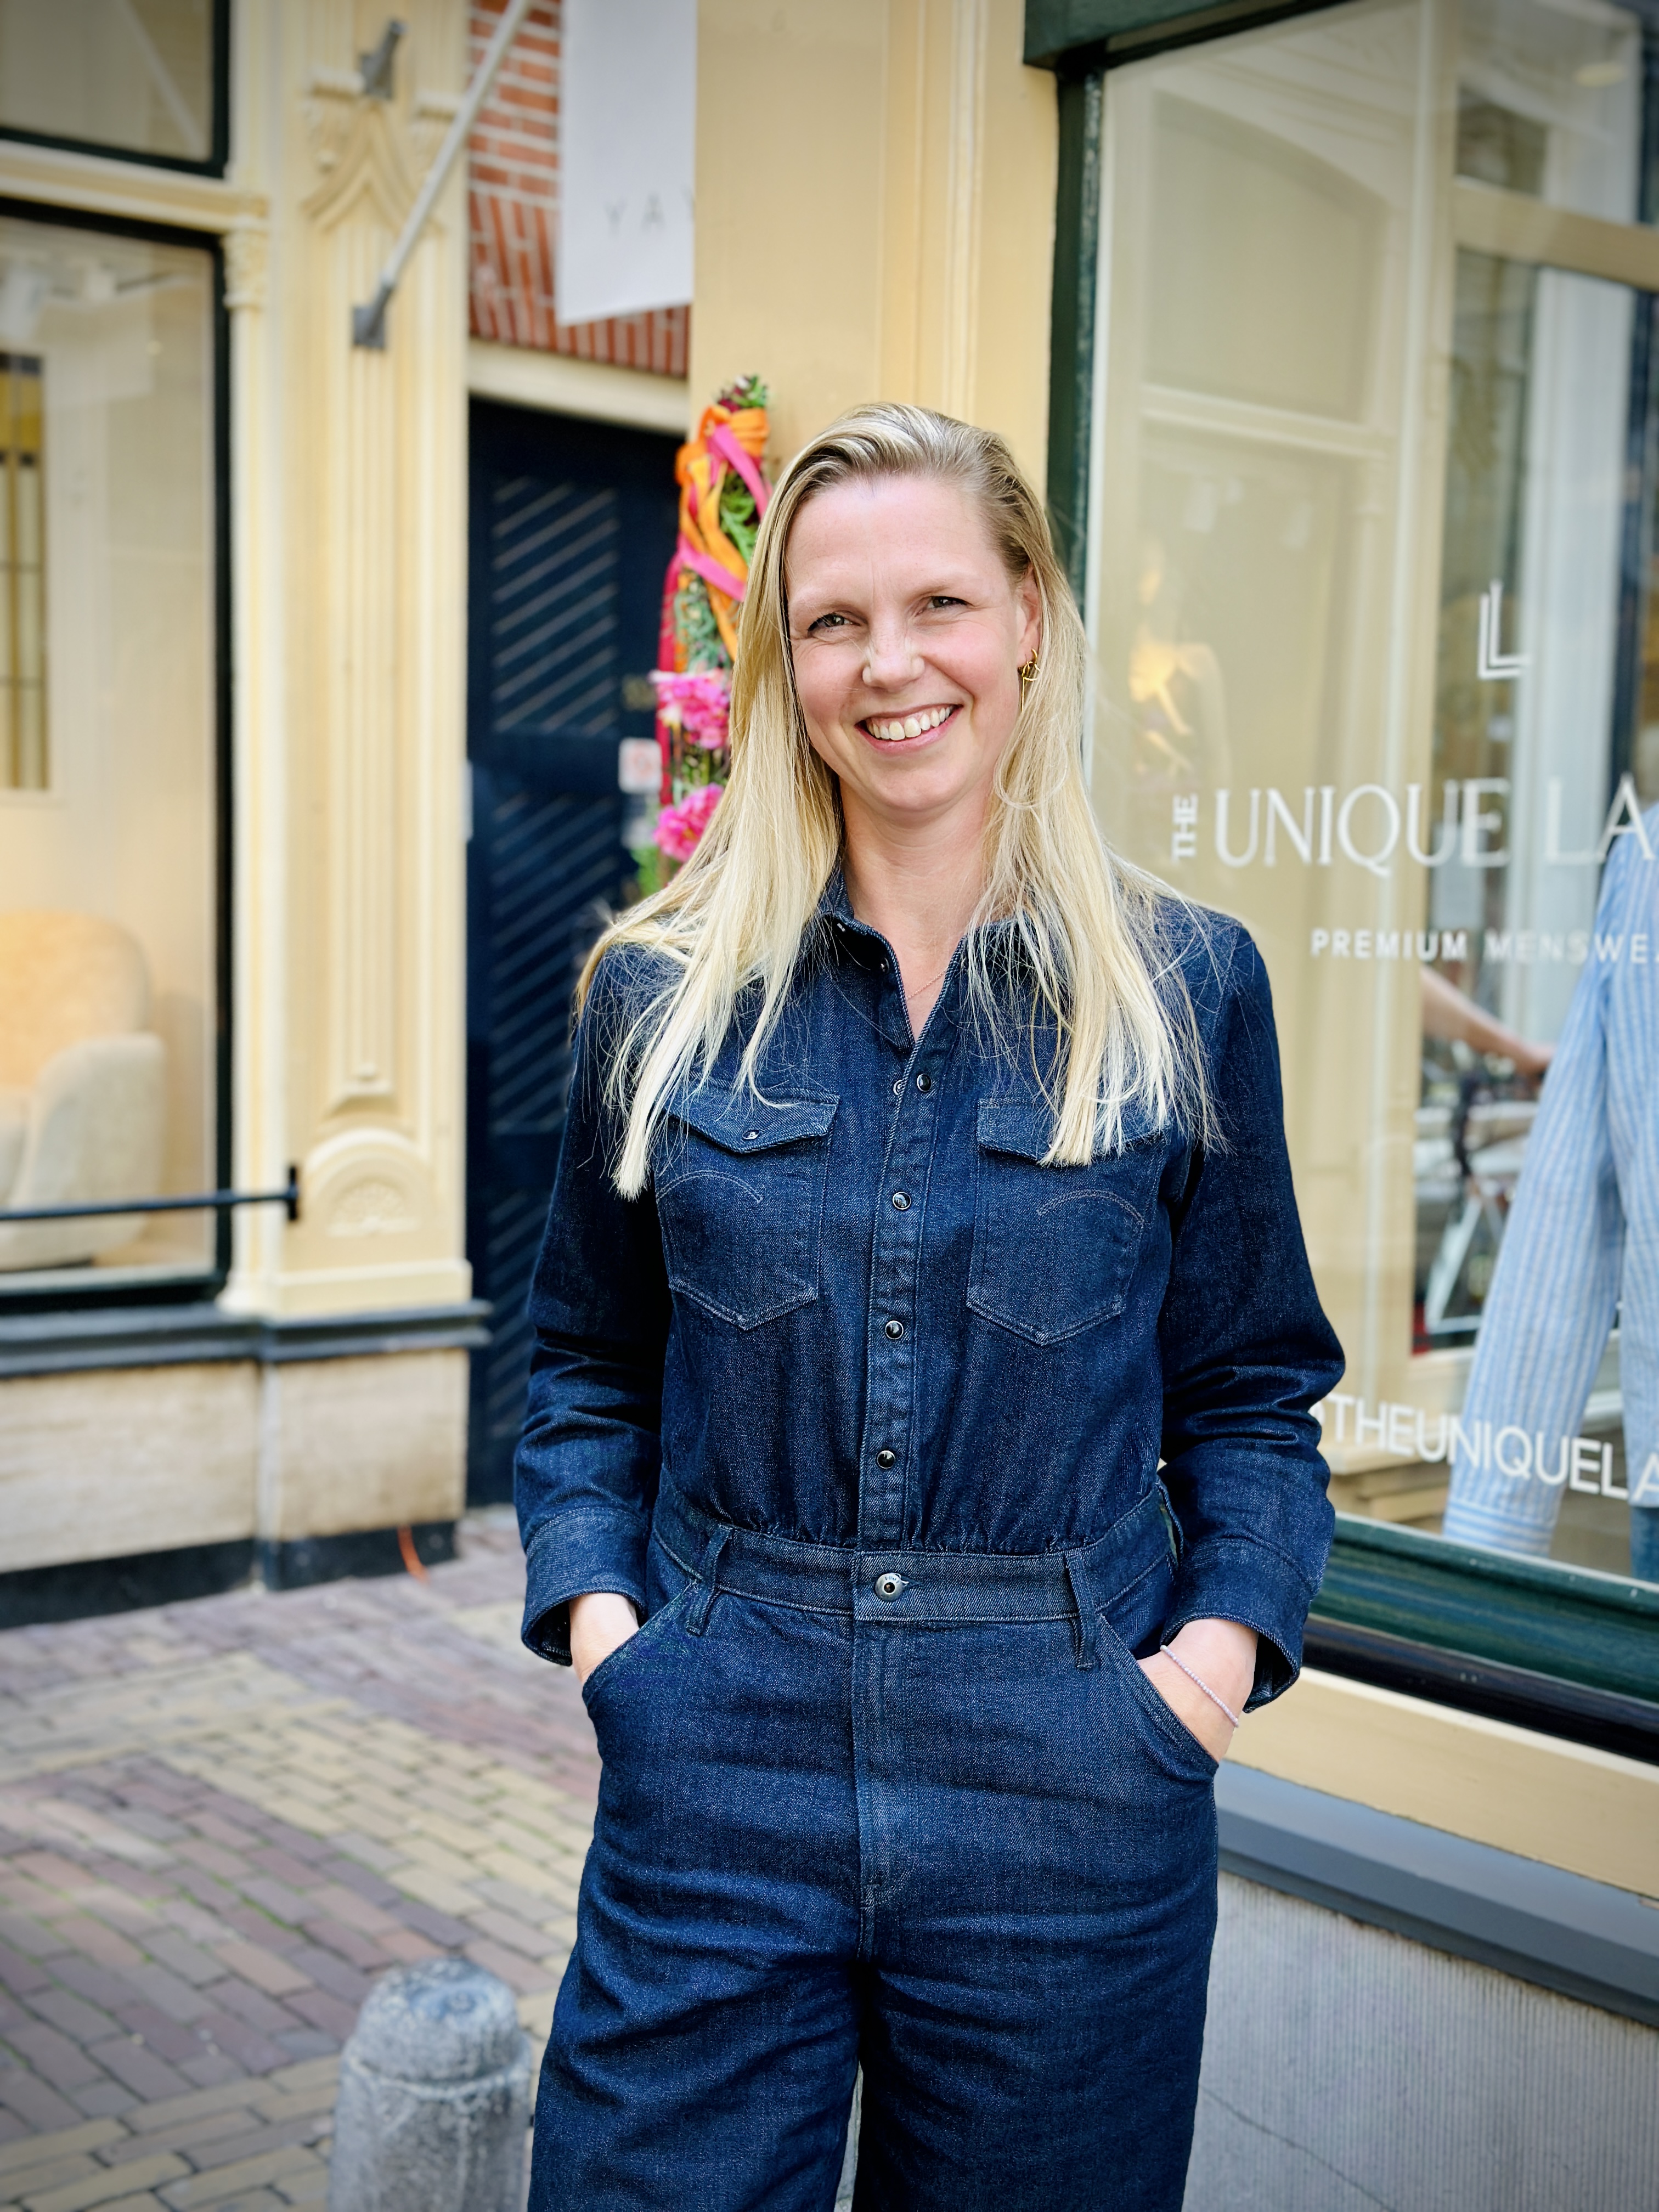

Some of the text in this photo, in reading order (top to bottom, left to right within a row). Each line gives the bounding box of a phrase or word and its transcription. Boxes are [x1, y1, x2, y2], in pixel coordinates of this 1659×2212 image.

[1171, 771, 1656, 877] THE UNIQUE LA
[1310, 927, 1659, 964] PREMIUM MENSWE
